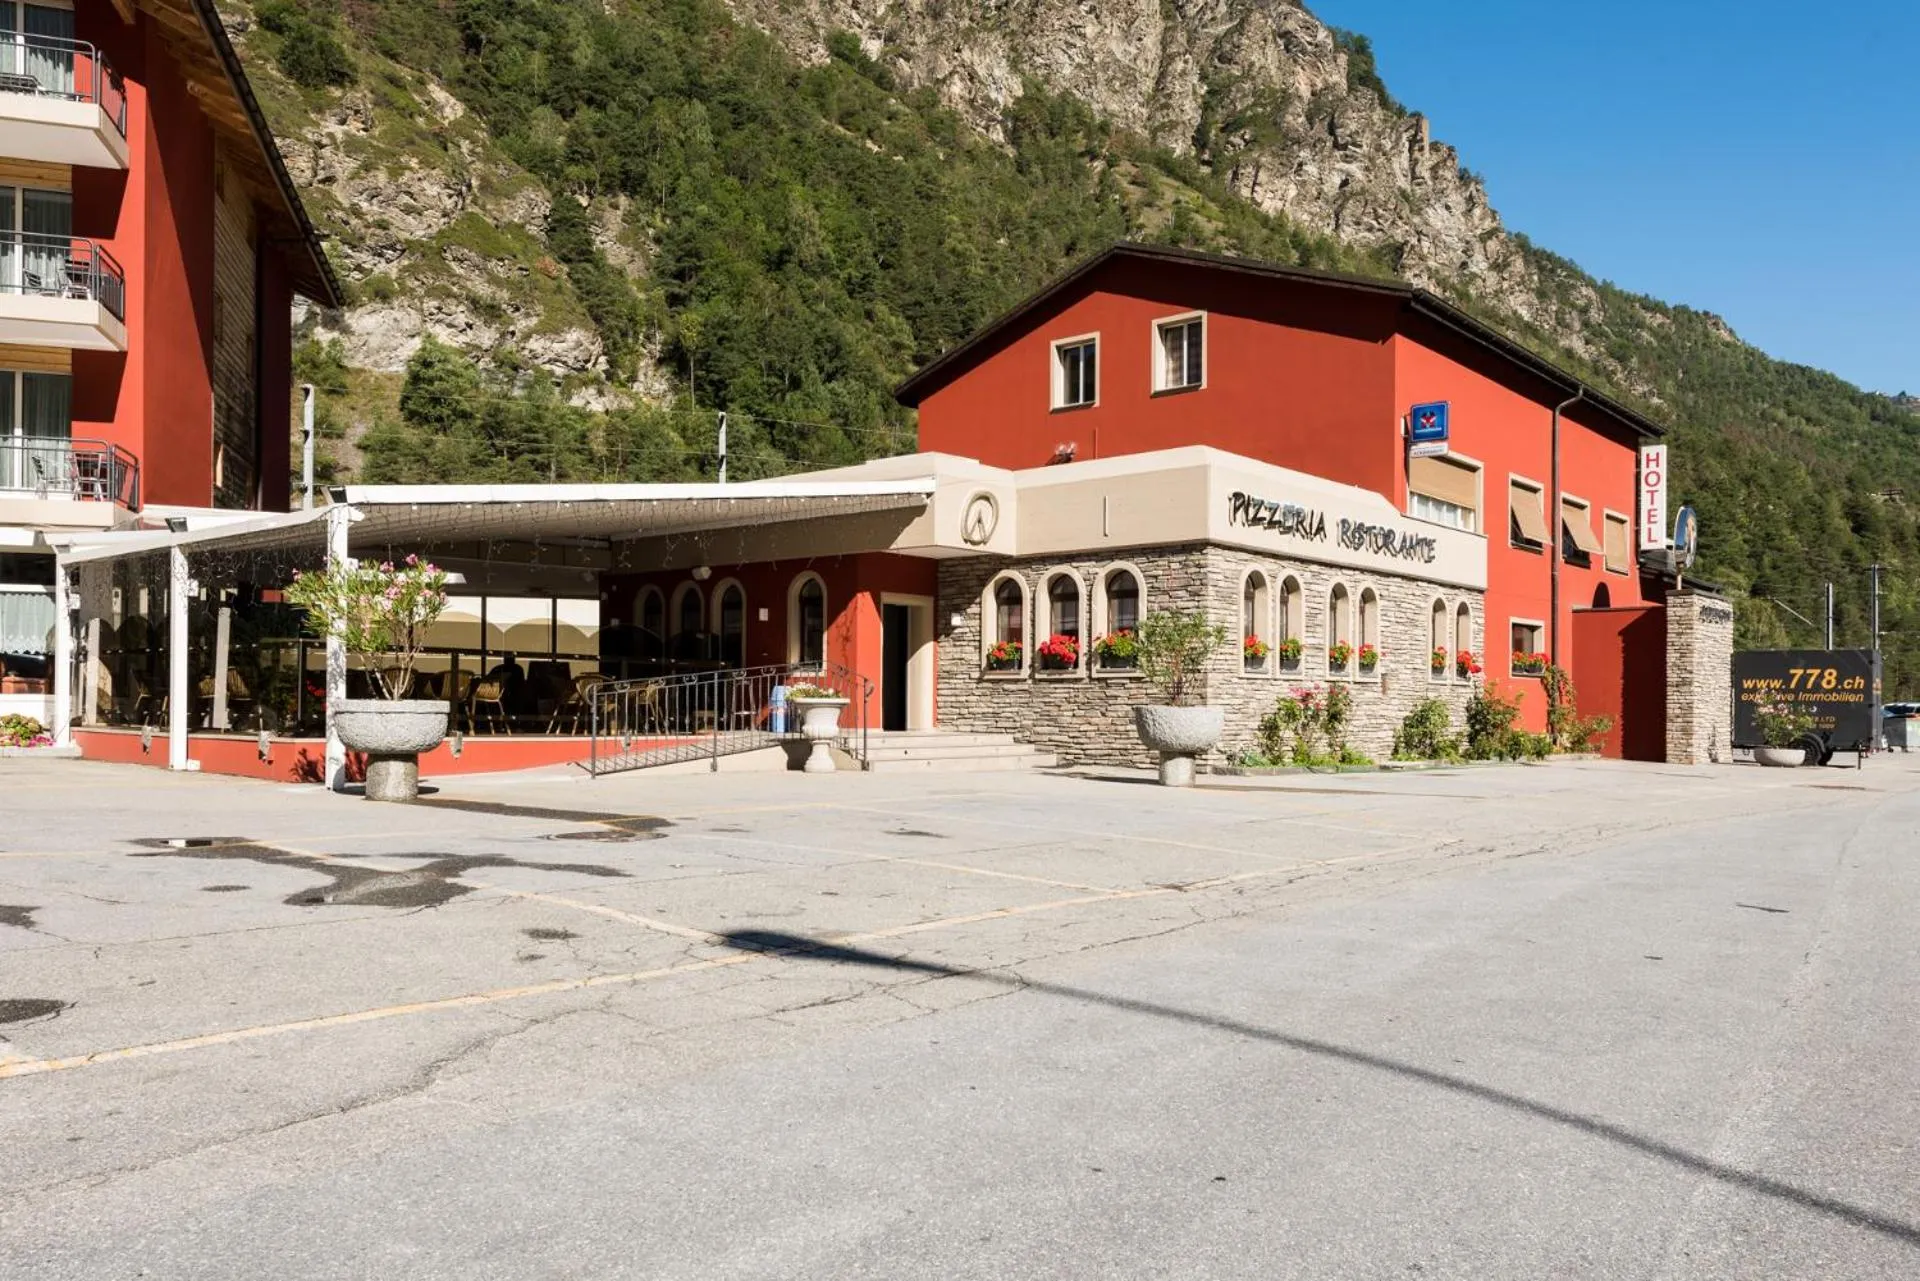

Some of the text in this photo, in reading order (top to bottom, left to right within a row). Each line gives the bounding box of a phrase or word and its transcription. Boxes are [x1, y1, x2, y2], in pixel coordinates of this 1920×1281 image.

[1644, 452, 1661, 543] HOTEL
[1229, 491, 1436, 563] PIZZERIA RISTORANTE
[1742, 668, 1865, 690] www.778.ch
[1799, 691, 1865, 702] Immobilien
